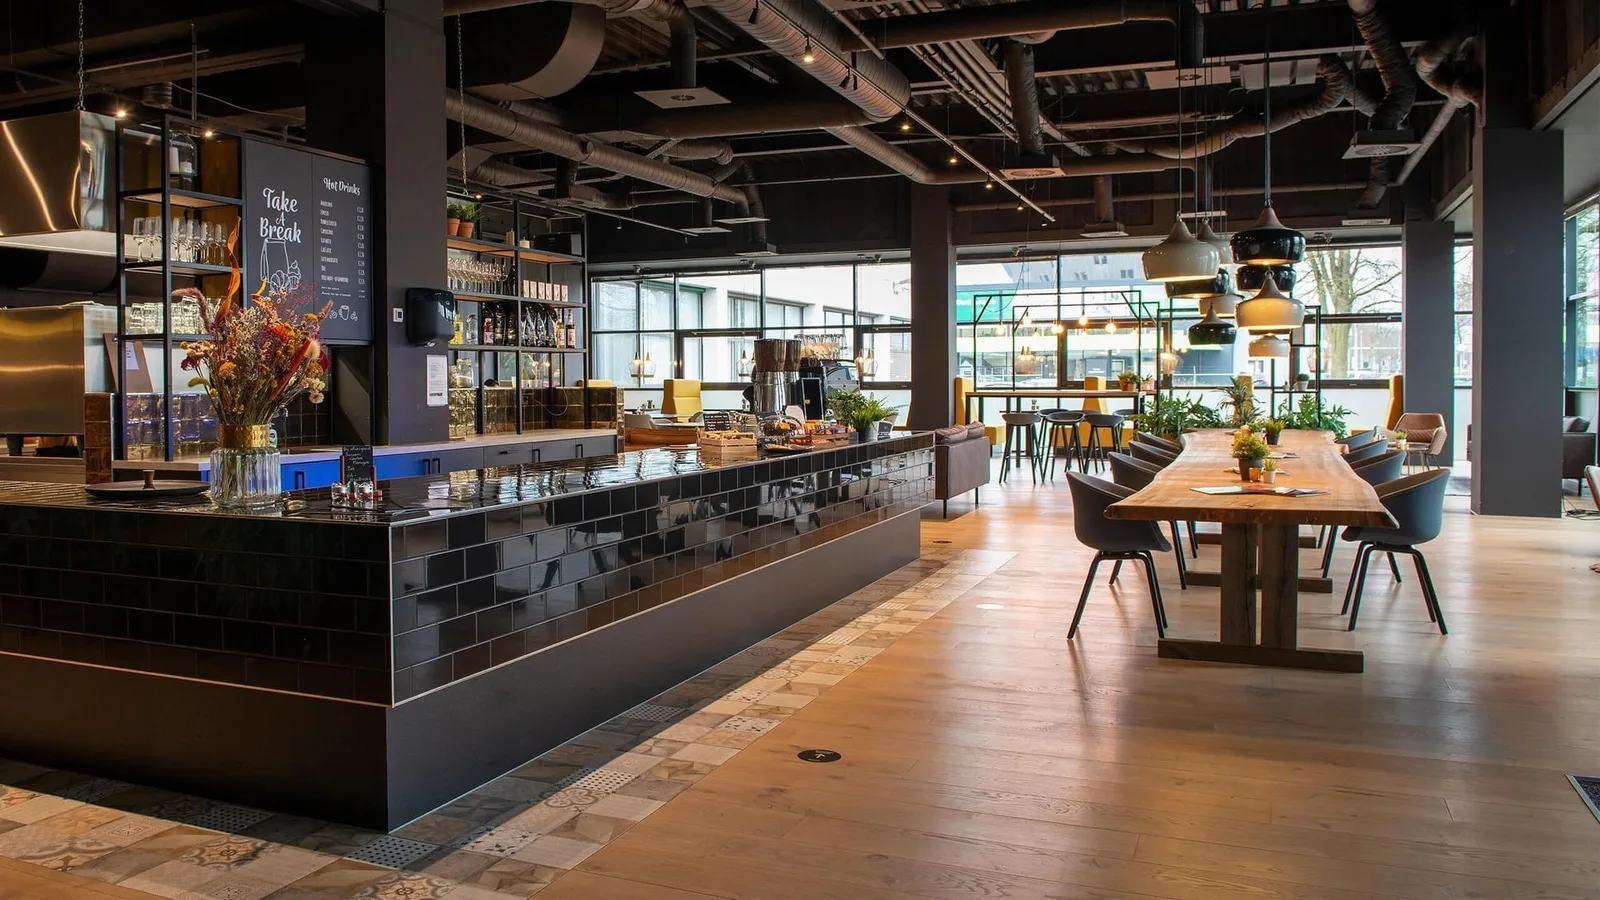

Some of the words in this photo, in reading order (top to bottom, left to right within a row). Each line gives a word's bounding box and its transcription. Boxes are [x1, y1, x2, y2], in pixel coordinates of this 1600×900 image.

[323, 177, 338, 191] Hot
[338, 180, 360, 196] Drinks
[262, 187, 299, 213] Take
[260, 216, 302, 243] Break
[275, 211, 286, 226] A
